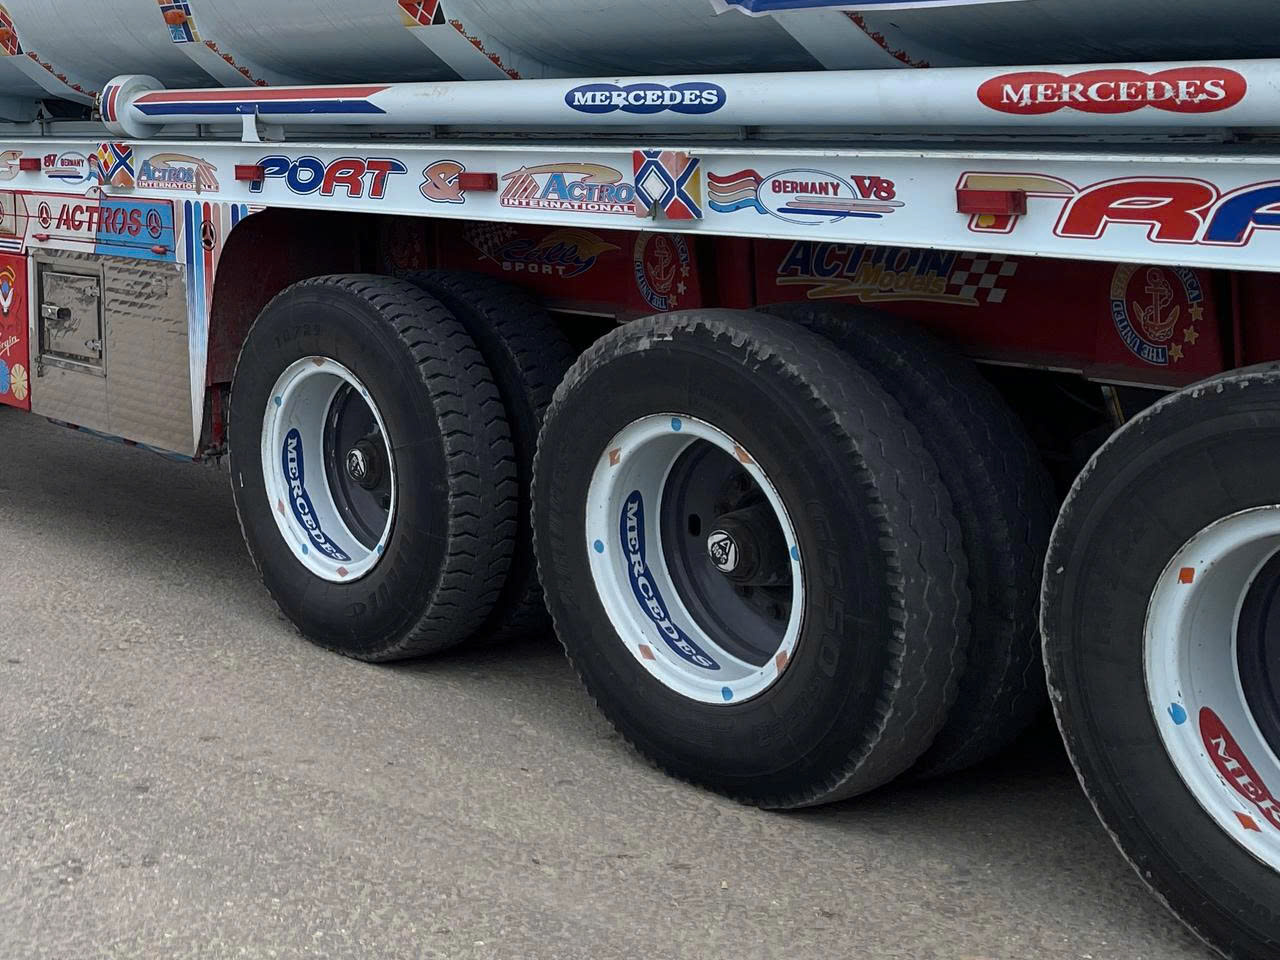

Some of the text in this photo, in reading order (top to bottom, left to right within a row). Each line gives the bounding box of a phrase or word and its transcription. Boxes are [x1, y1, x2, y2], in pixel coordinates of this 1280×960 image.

[572, 89, 719, 107] MERCEDES
[999, 78, 1226, 107] MERCEDES
[247, 154, 409, 200] PORT
[539, 172, 635, 204] ACTRO
[771, 175, 897, 202] GERMANY V8
[55, 202, 142, 237] ACTROS
[503, 198, 636, 214] INTERNATIONAL
[287, 437, 348, 562] MERCEDES
[625, 499, 713, 669] MERCEDES
